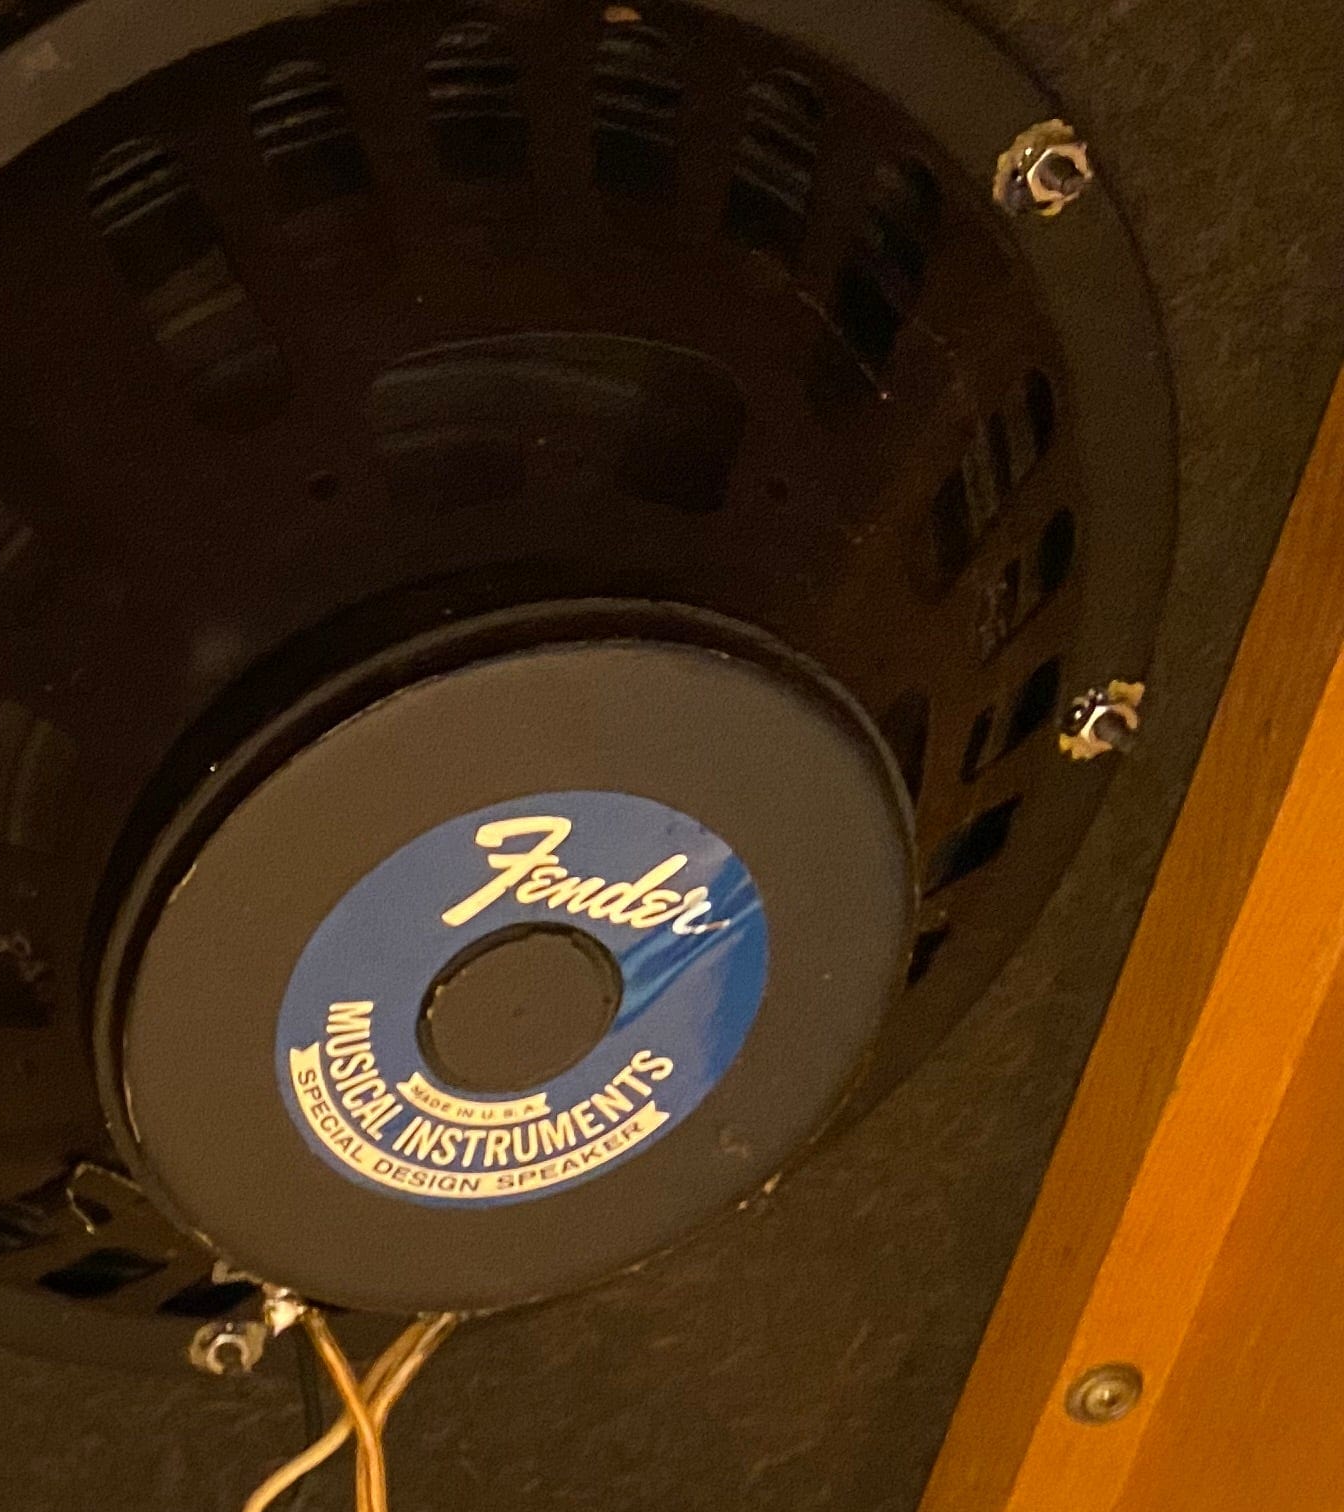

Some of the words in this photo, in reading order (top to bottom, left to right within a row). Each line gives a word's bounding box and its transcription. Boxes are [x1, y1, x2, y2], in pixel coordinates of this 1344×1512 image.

[441, 816, 730, 935] Fender
[298, 1069, 363, 1164] SPECIAL
[373, 1157, 481, 1193] DESIGN
[496, 1121, 646, 1191] SPEAKER
[325, 1001, 404, 1141] MUSICAL
[392, 1049, 674, 1168] INSTRUMENTS
[411, 1085, 452, 1114] MADE
[457, 1106, 474, 1119] IN
